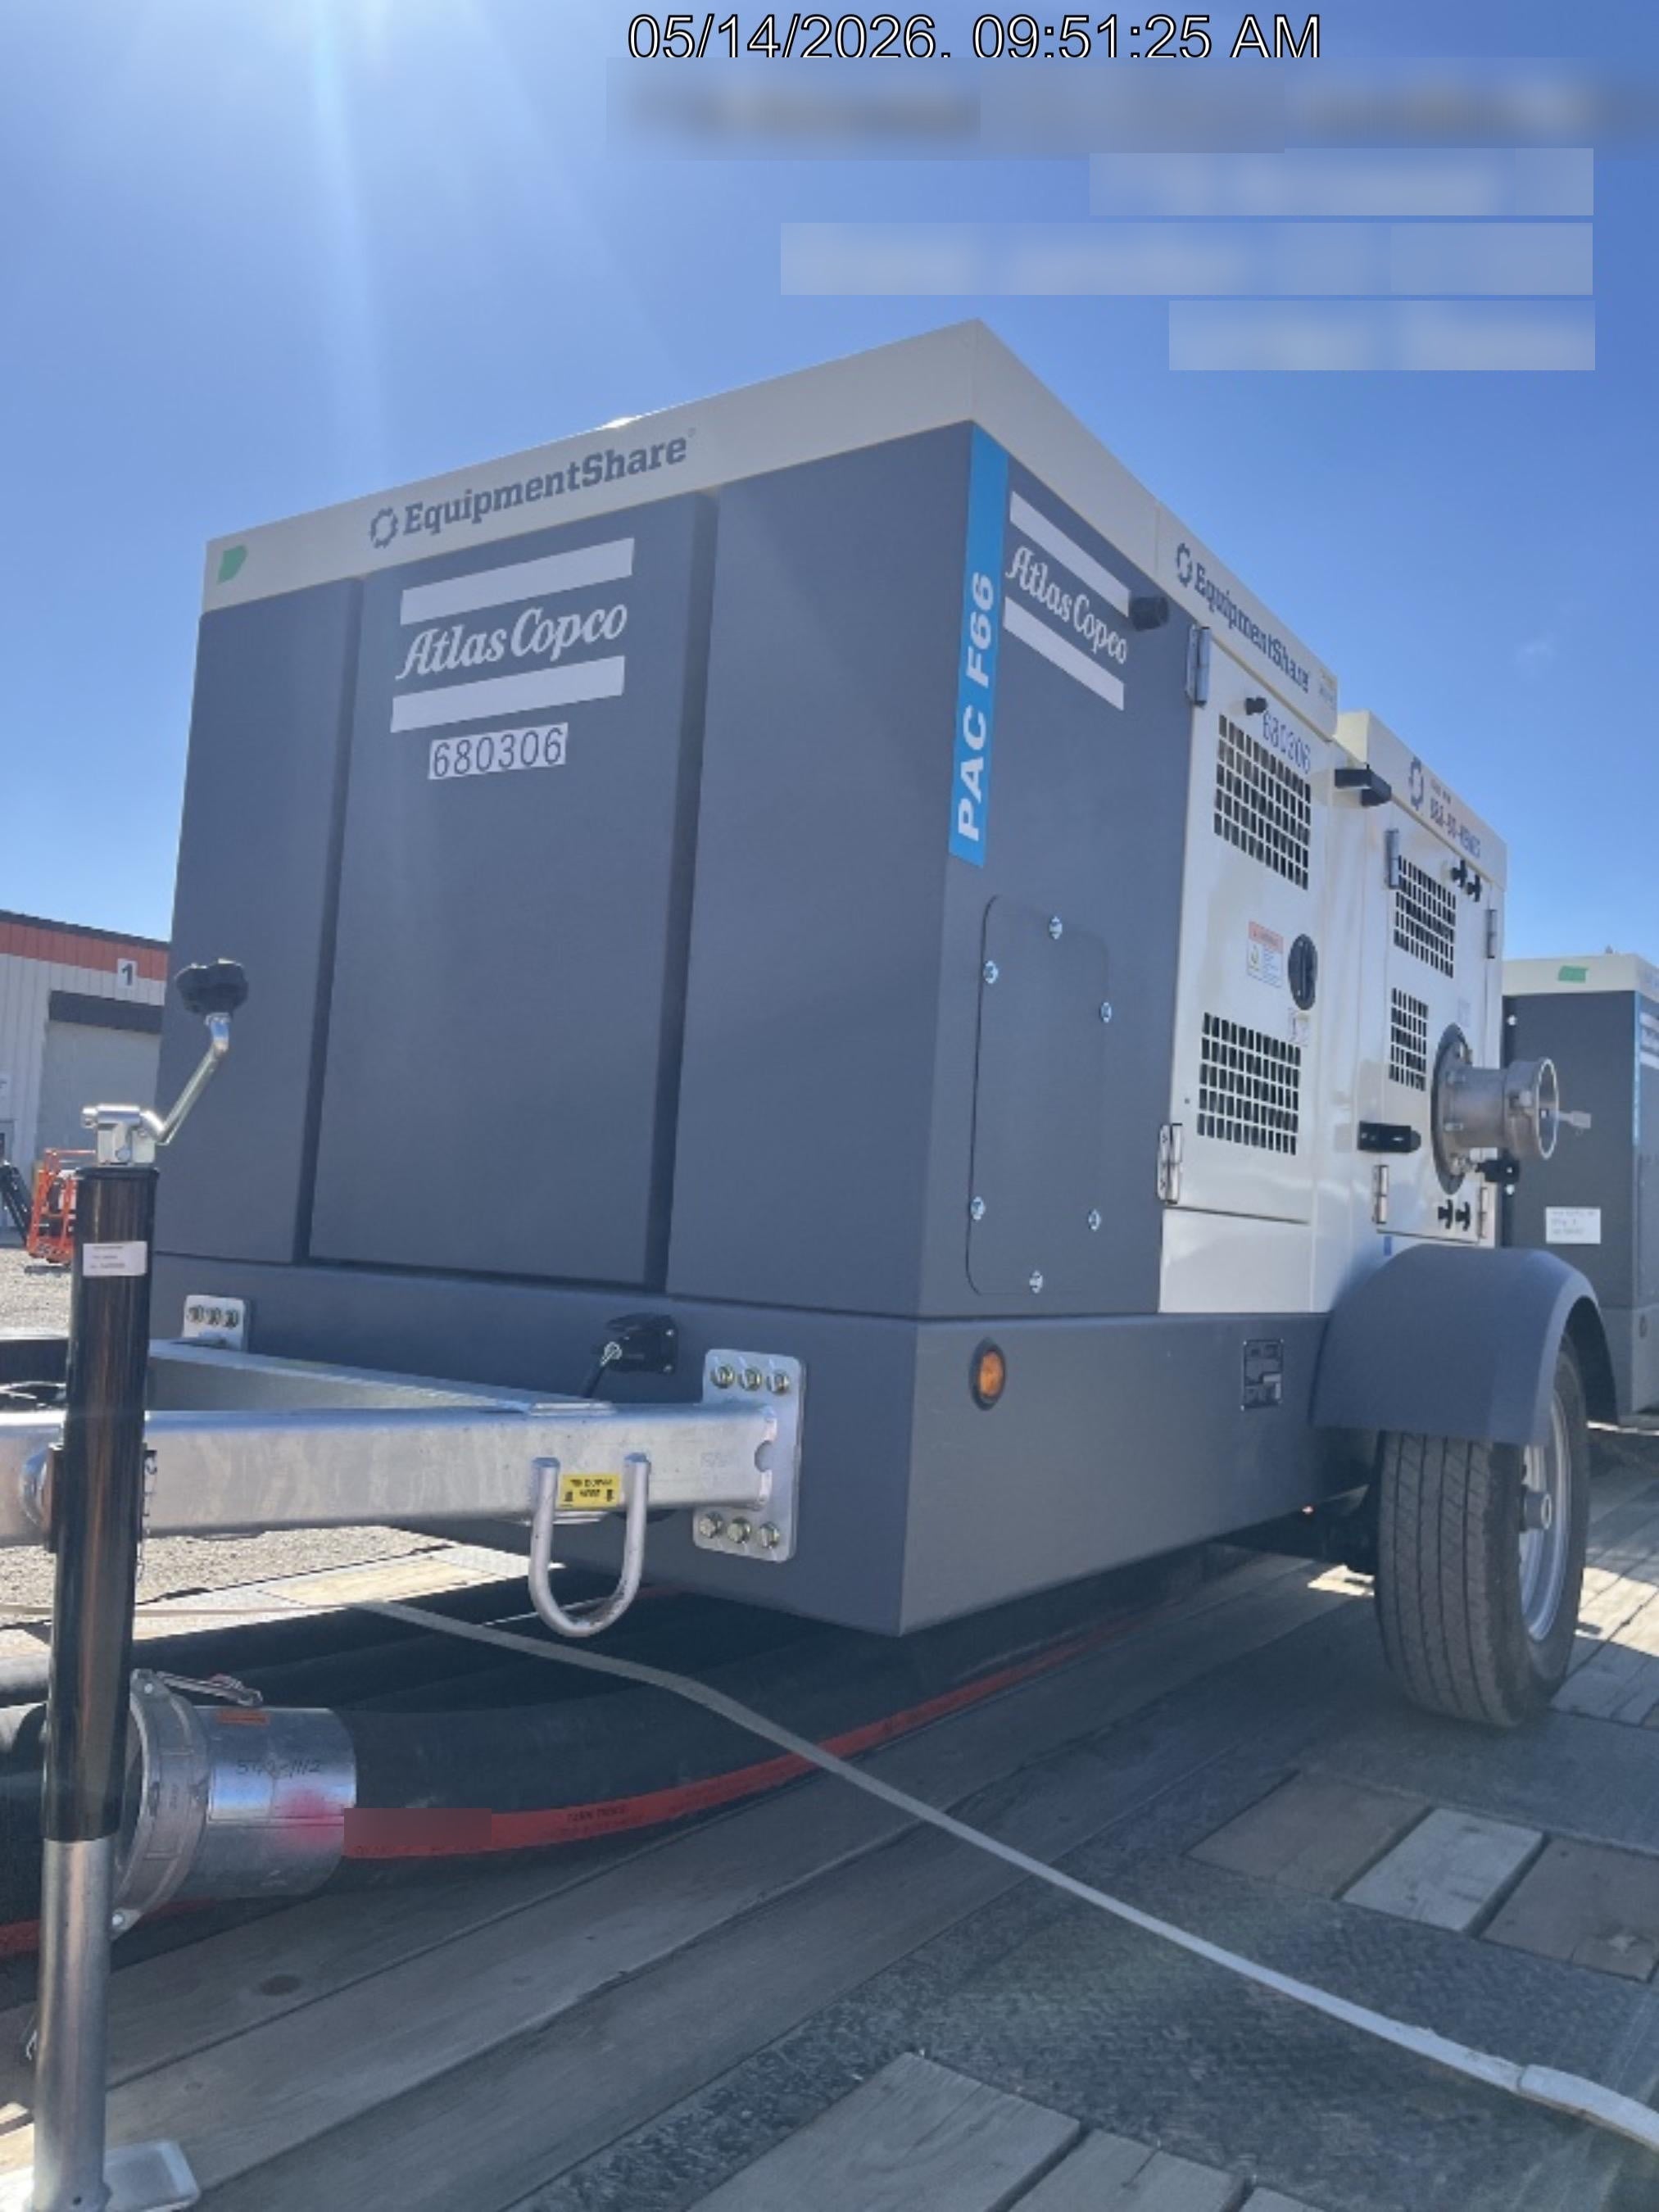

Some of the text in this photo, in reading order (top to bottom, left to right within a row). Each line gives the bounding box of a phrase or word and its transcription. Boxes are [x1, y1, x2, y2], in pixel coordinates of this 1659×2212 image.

[402, 436, 687, 536] EquipmentShare
[395, 604, 628, 682] Atlas Copco
[1004, 546, 1127, 665] Atlas Copco
[1194, 562, 1309, 694] EquipmentShare
[433, 727, 564, 778] 680306
[958, 572, 995, 842] PAC F66
[122, 963, 133, 986] 1
